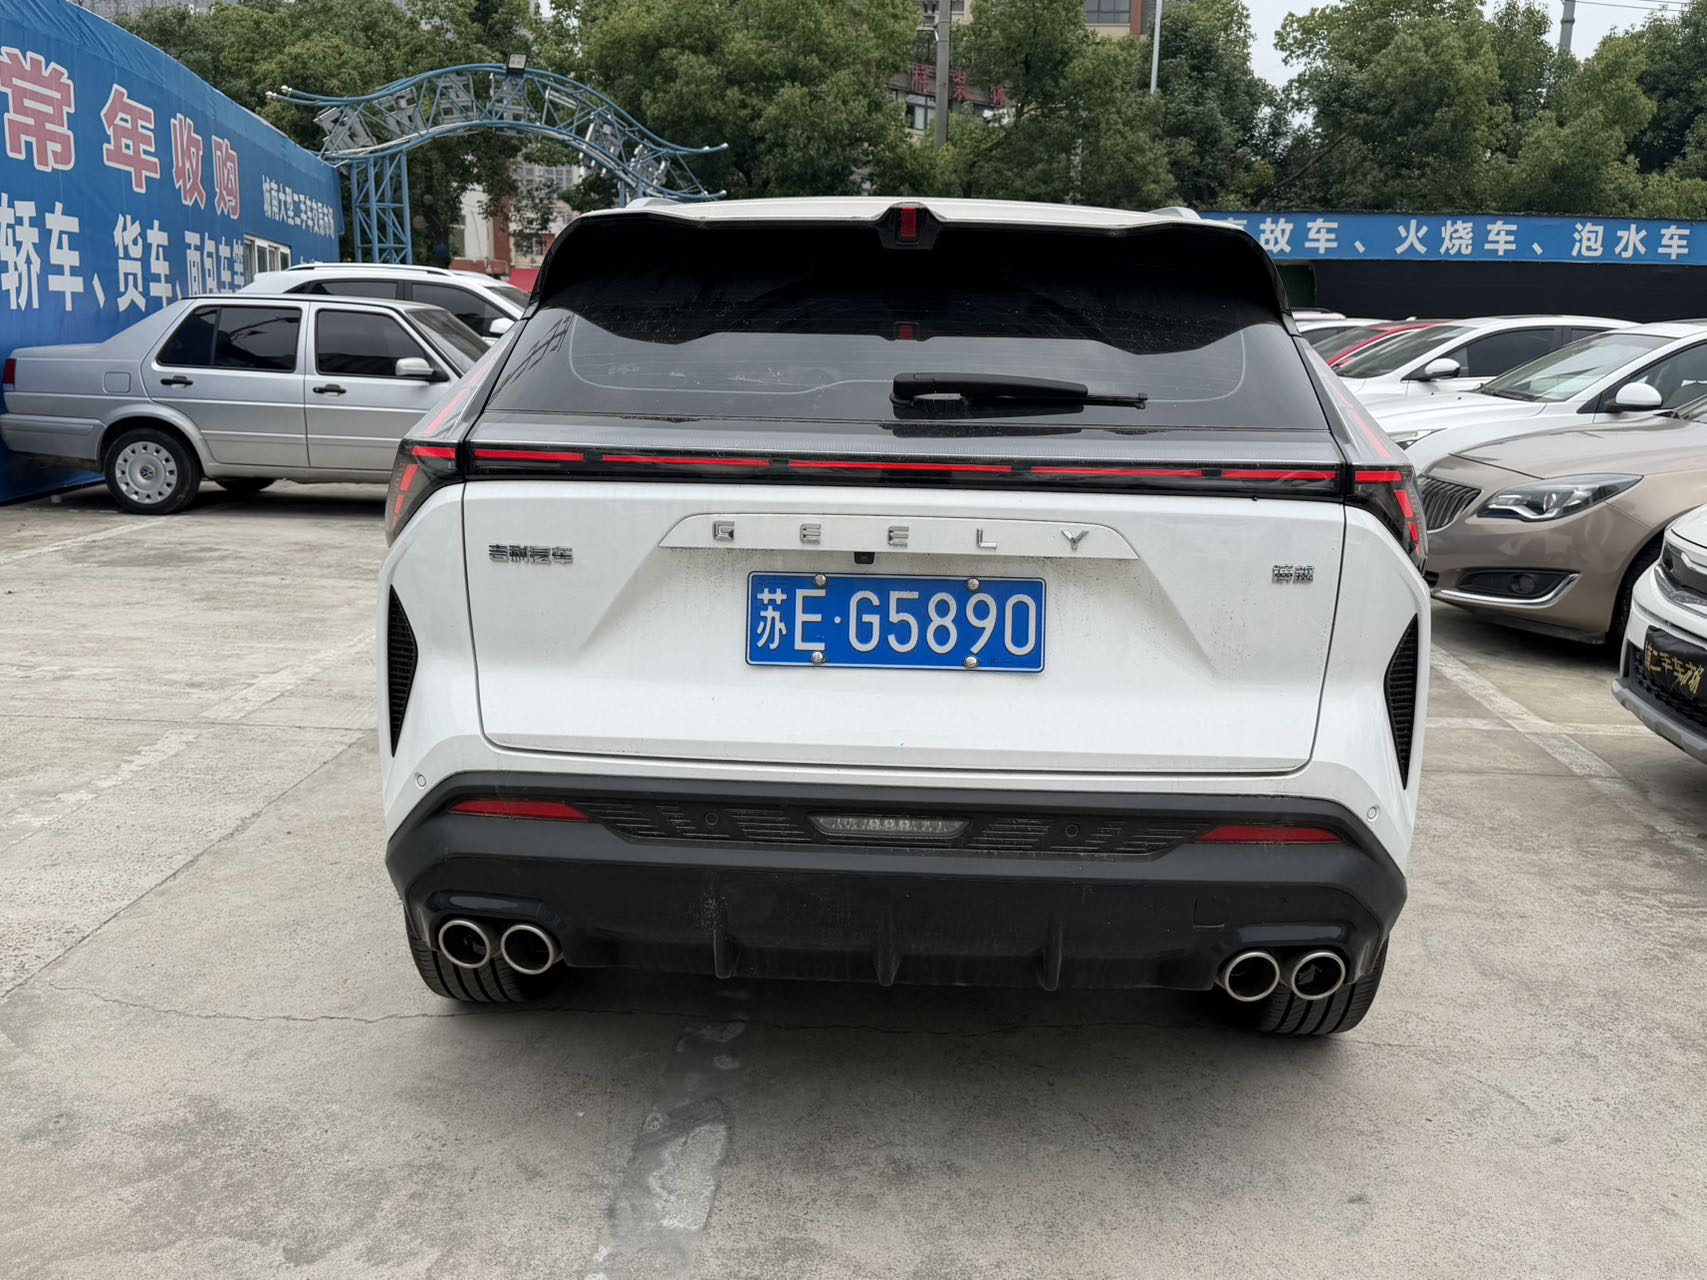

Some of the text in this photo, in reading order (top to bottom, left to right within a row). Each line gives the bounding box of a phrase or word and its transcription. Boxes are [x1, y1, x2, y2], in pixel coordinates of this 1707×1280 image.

[0, 46, 241, 220] 常年收购
[1226, 217, 1691, 260] 故车、火烧车、泡水车
[712, 520, 1090, 551] GEELY
[756, 588, 1037, 656] 苏E·G5890
